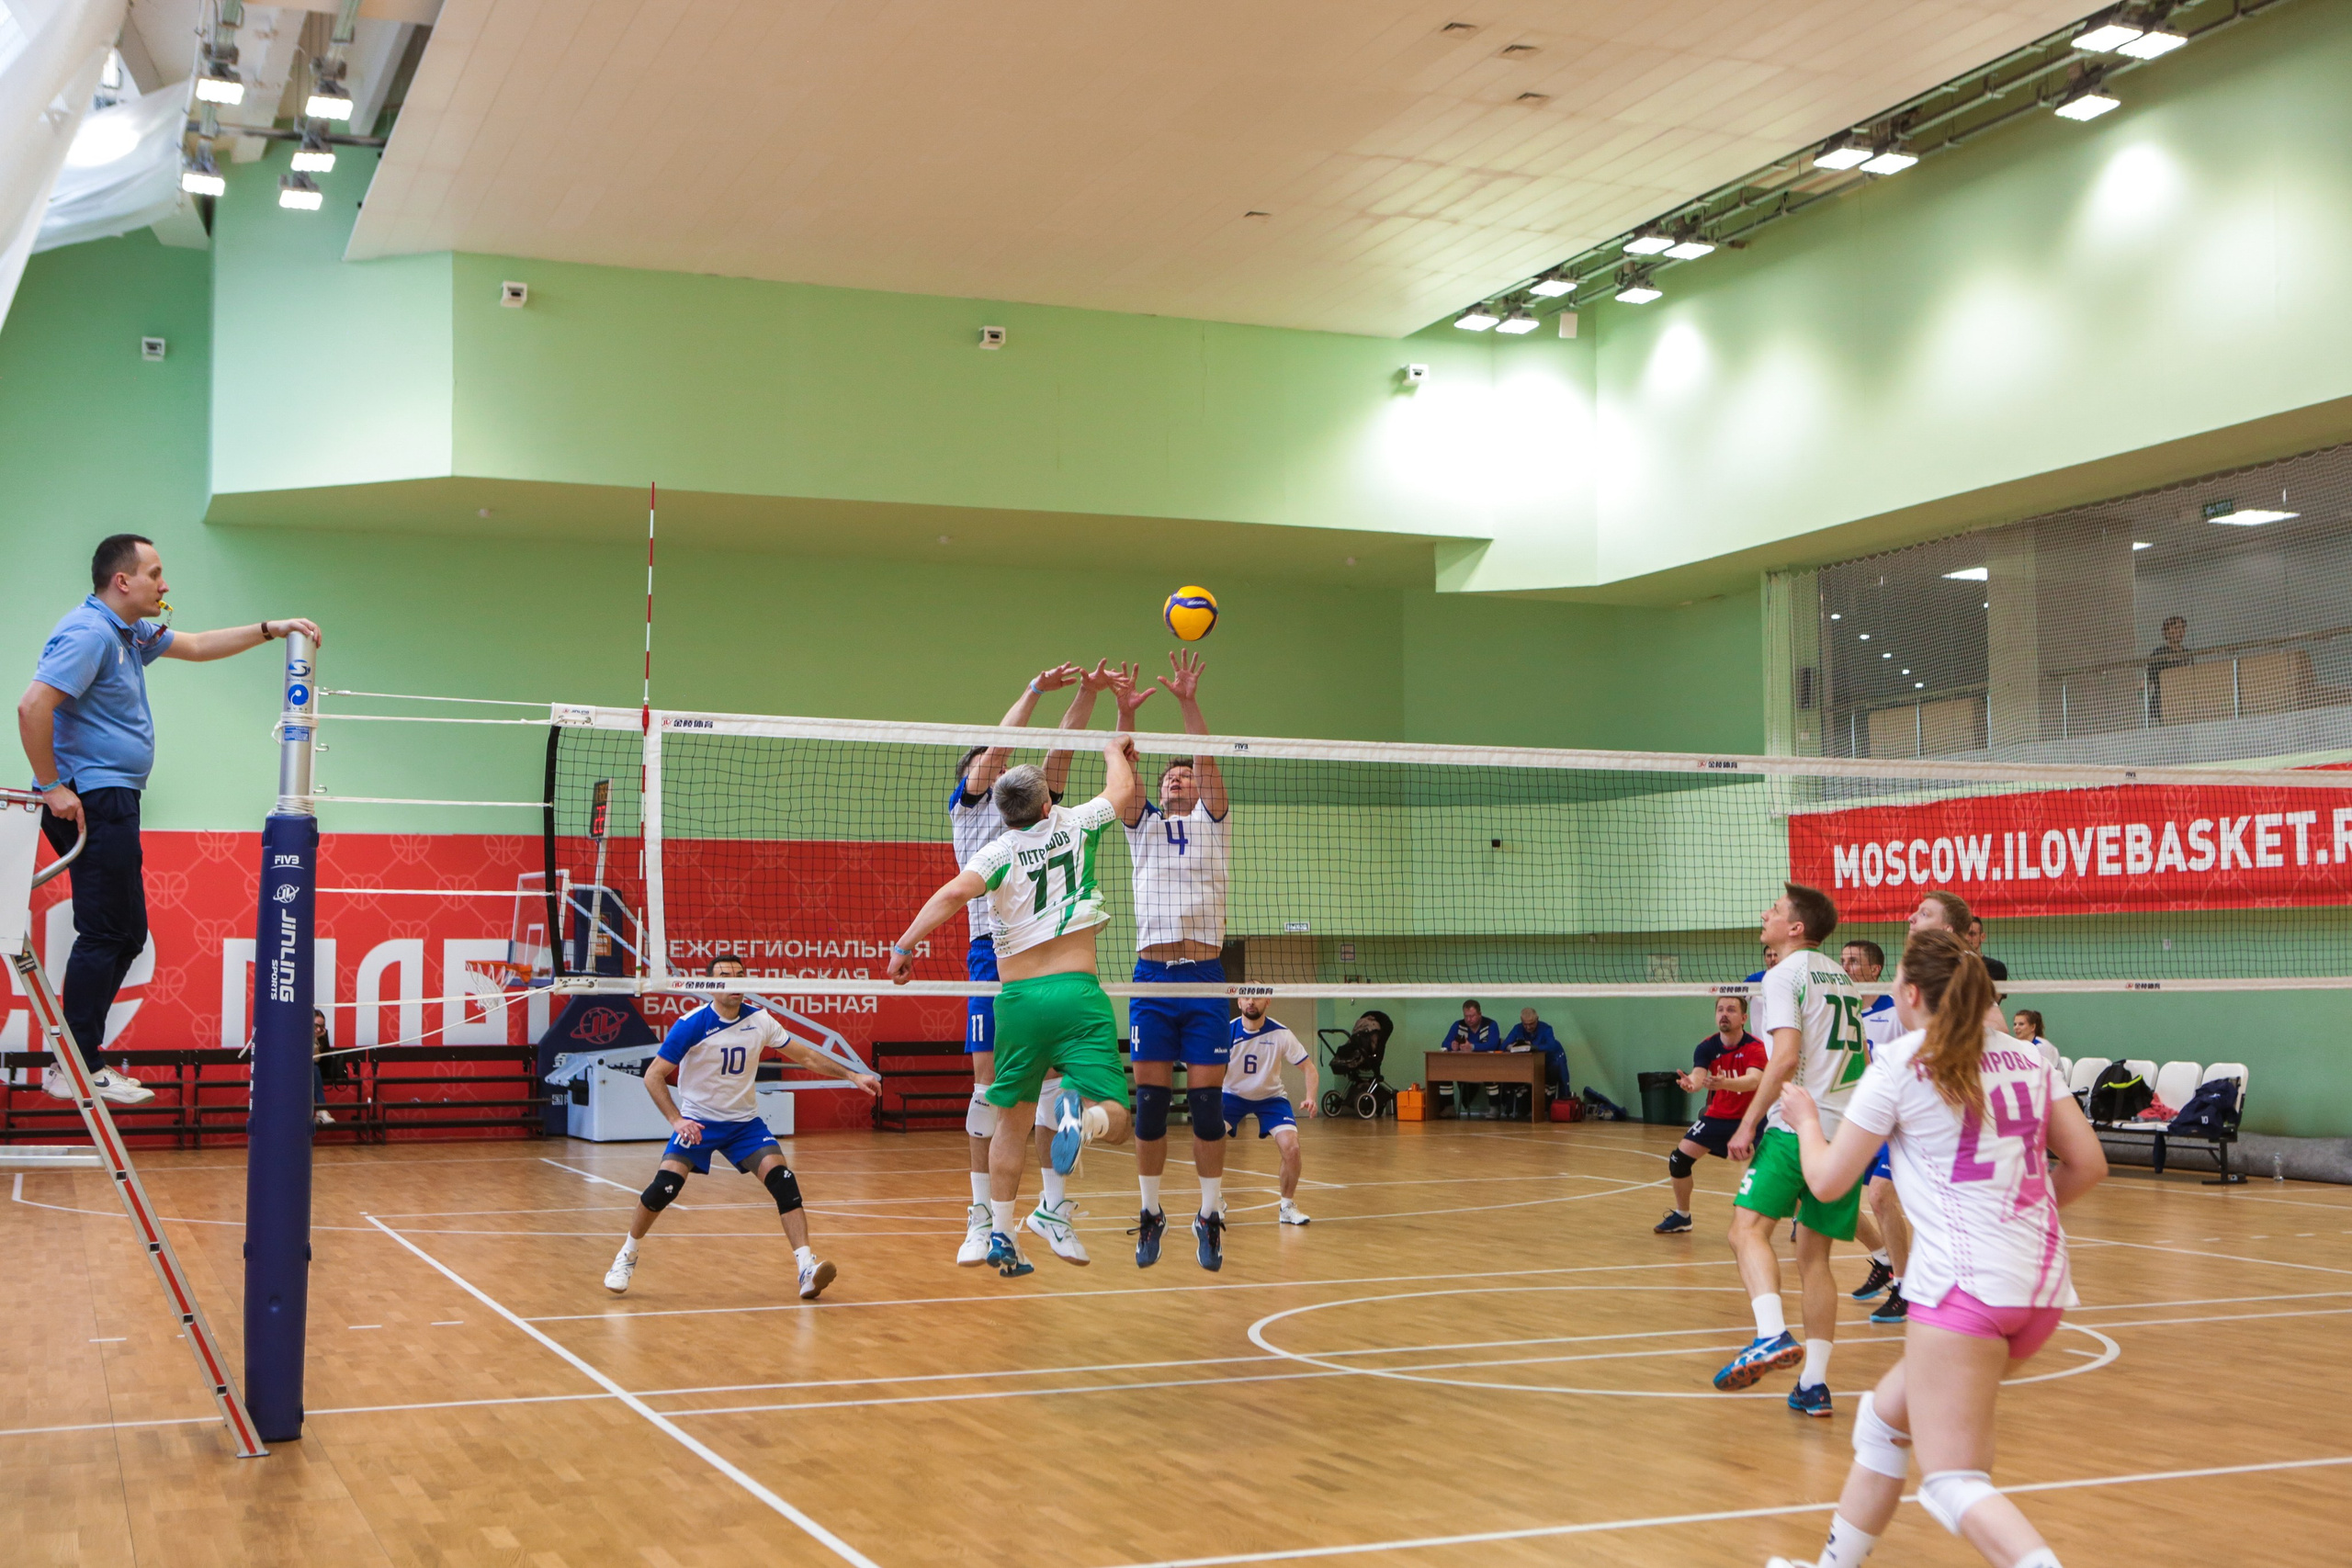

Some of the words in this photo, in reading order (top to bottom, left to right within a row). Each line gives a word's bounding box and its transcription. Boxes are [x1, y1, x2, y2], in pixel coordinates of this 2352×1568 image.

[1164, 819, 1188, 855] 4
[274, 854, 300, 865] FIVB
[279, 908, 297, 1003] JINLING
[644, 940, 931, 959] ЕЖРЕГИОНАЛЬНЯ
[270, 959, 279, 1000] SPORTS
[971, 1013, 984, 1043] 11
[1823, 994, 1862, 1053] 25
[1131, 1025, 1140, 1053] 4
[720, 1046, 746, 1076] 10
[1243, 1054, 1258, 1075] 6
[1951, 1081, 2041, 1183] 24
[2200, 1115, 2210, 1125] 10
